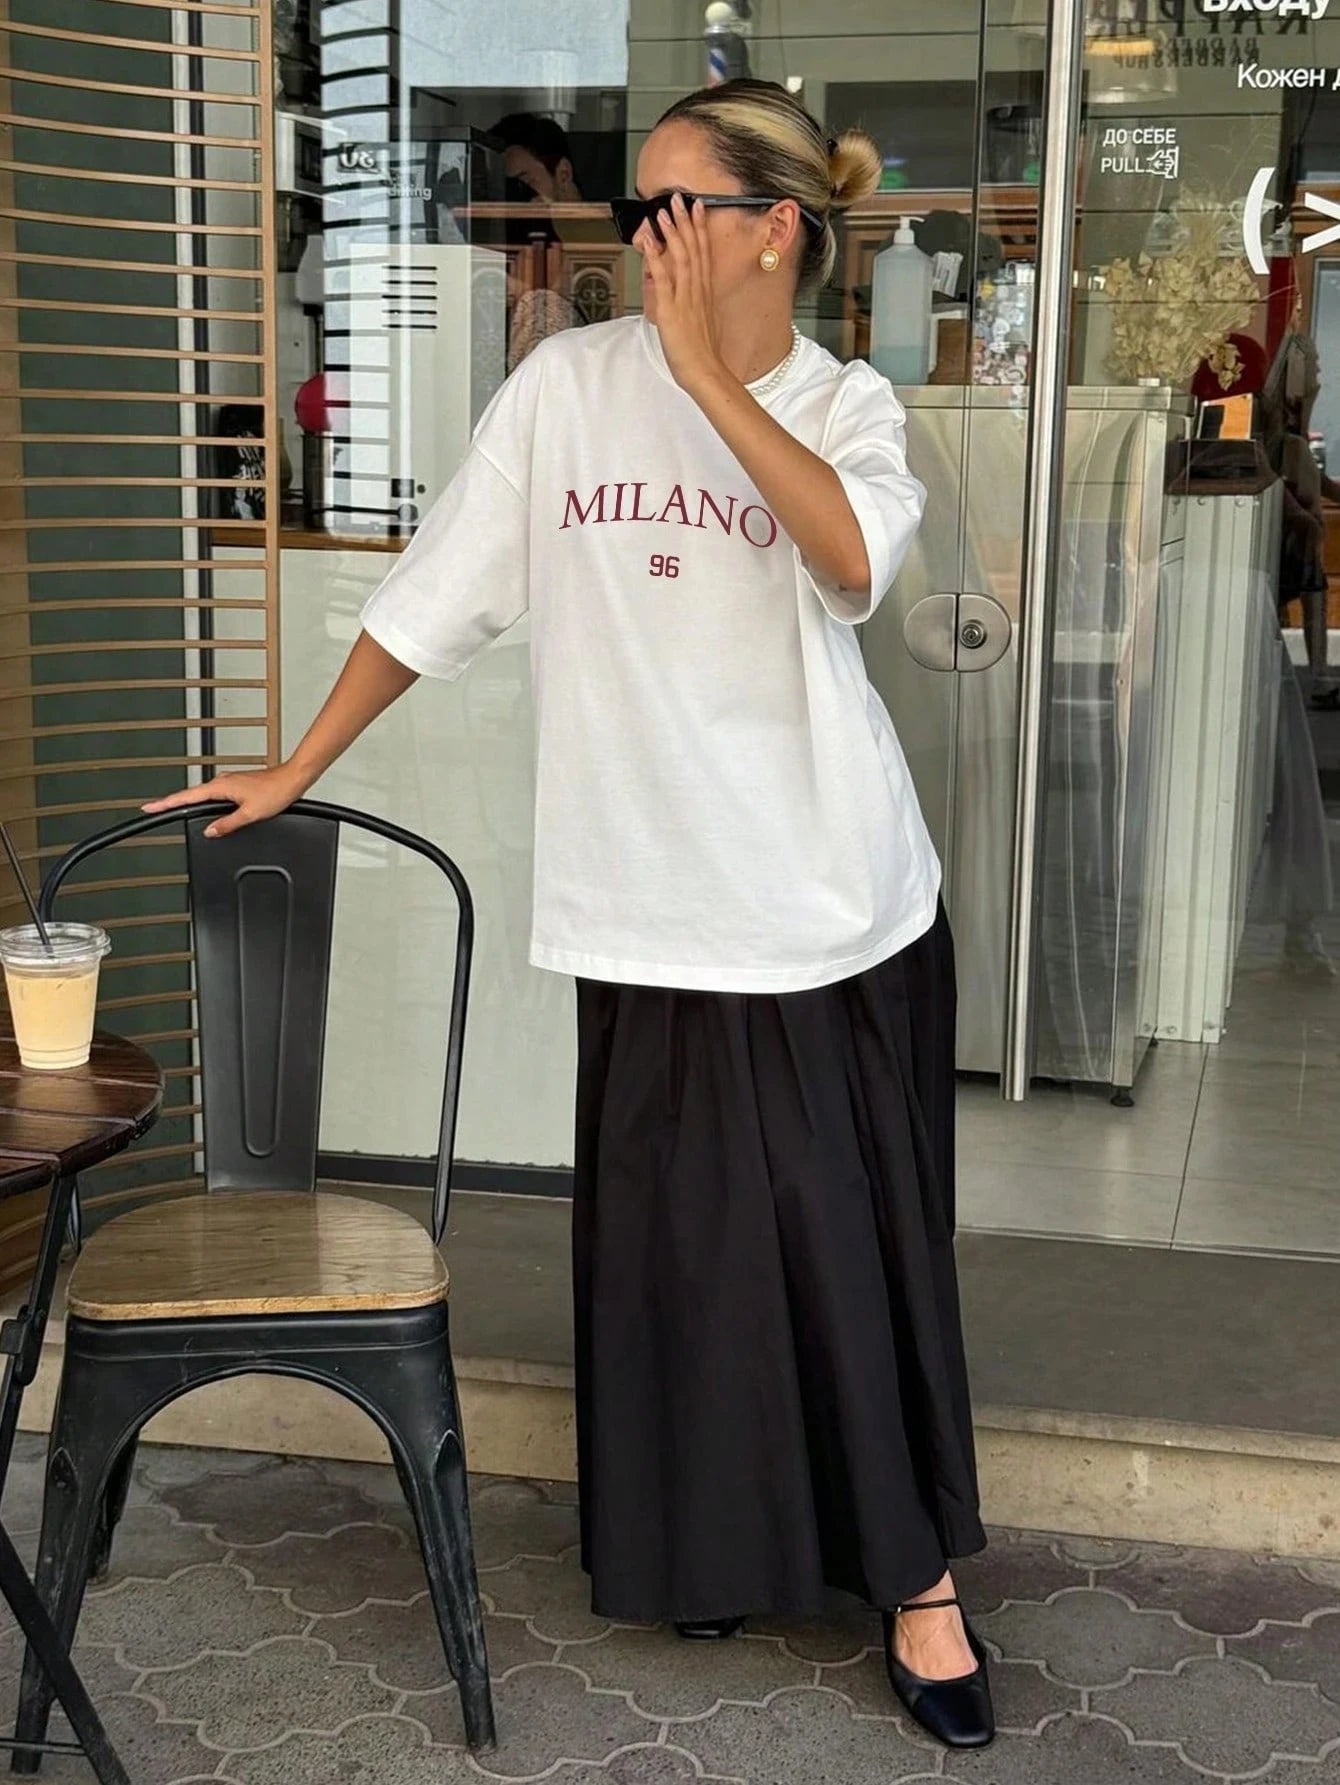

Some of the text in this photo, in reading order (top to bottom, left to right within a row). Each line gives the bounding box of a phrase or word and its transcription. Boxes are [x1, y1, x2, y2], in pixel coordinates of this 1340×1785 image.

[1237, 63, 1326, 88] Кожен
[1102, 127, 1177, 148] ДО СЕБЕ
[1101, 157, 1145, 173] PULL
[558, 482, 778, 548] MILANO
[649, 554, 681, 578] 96
